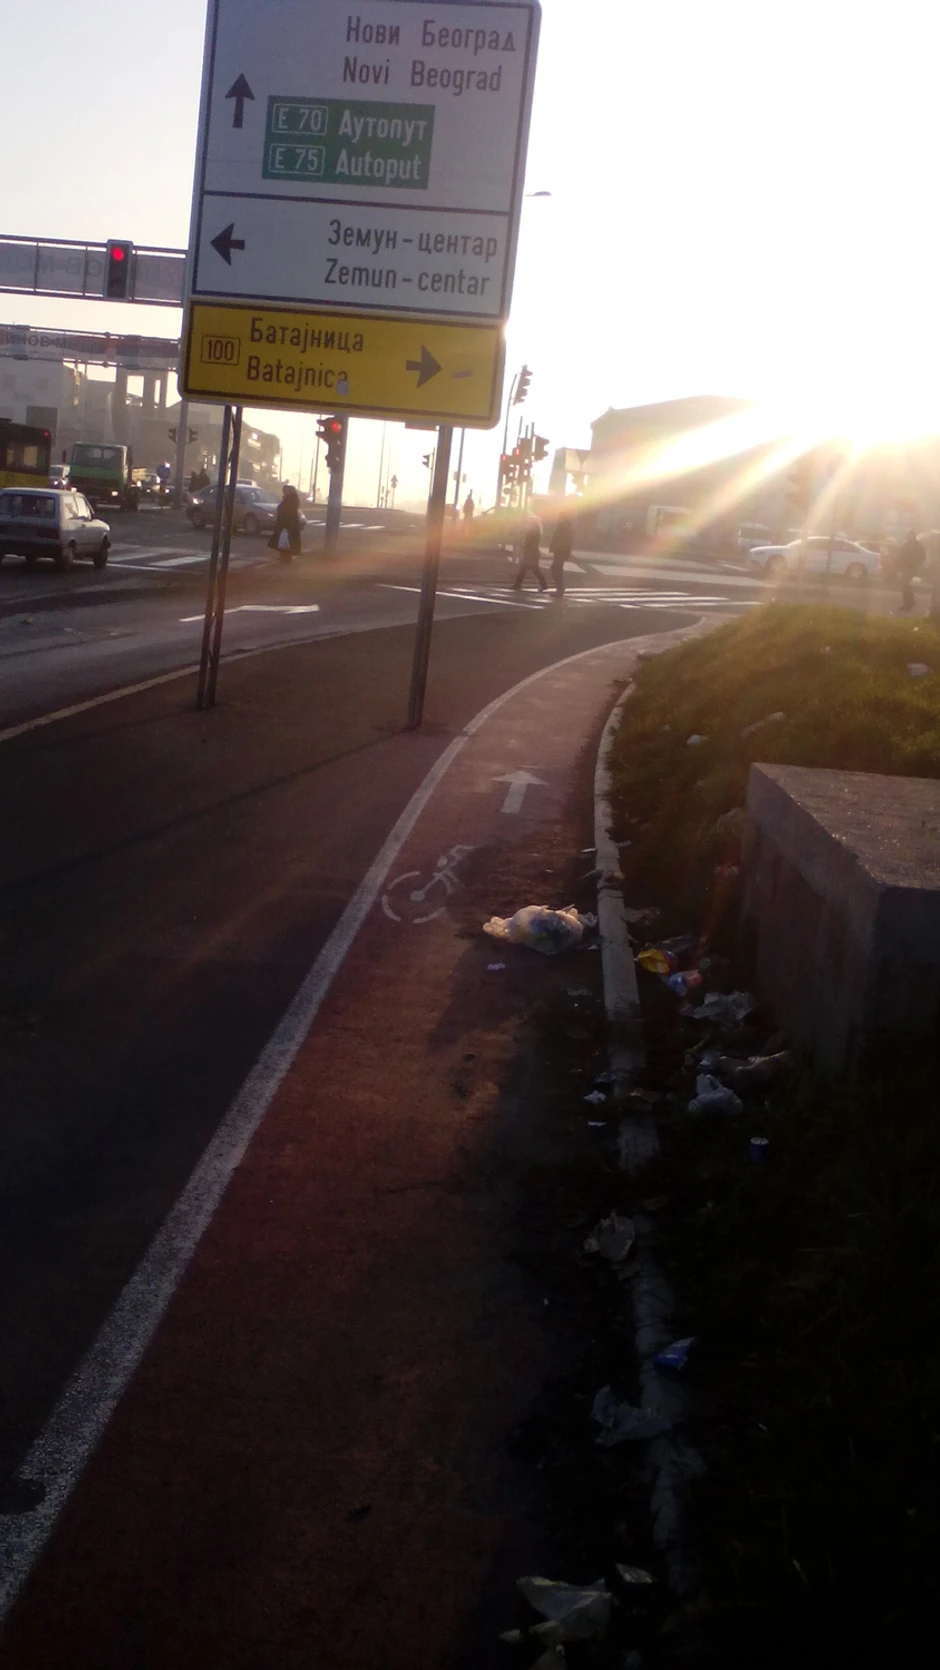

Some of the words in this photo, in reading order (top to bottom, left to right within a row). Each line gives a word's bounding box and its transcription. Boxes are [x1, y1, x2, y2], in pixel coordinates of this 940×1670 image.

[346, 16, 400, 45] Нови
[422, 20, 516, 56] Београд
[343, 56, 390, 85] Novi
[410, 60, 502, 96] Beograd
[300, 109, 322, 132] 70
[339, 111, 427, 146] Аутопут
[296, 149, 318, 172] 75
[335, 149, 422, 183] Autoput
[207, 339, 235, 361] 100
[250, 317, 364, 354] Батајница
